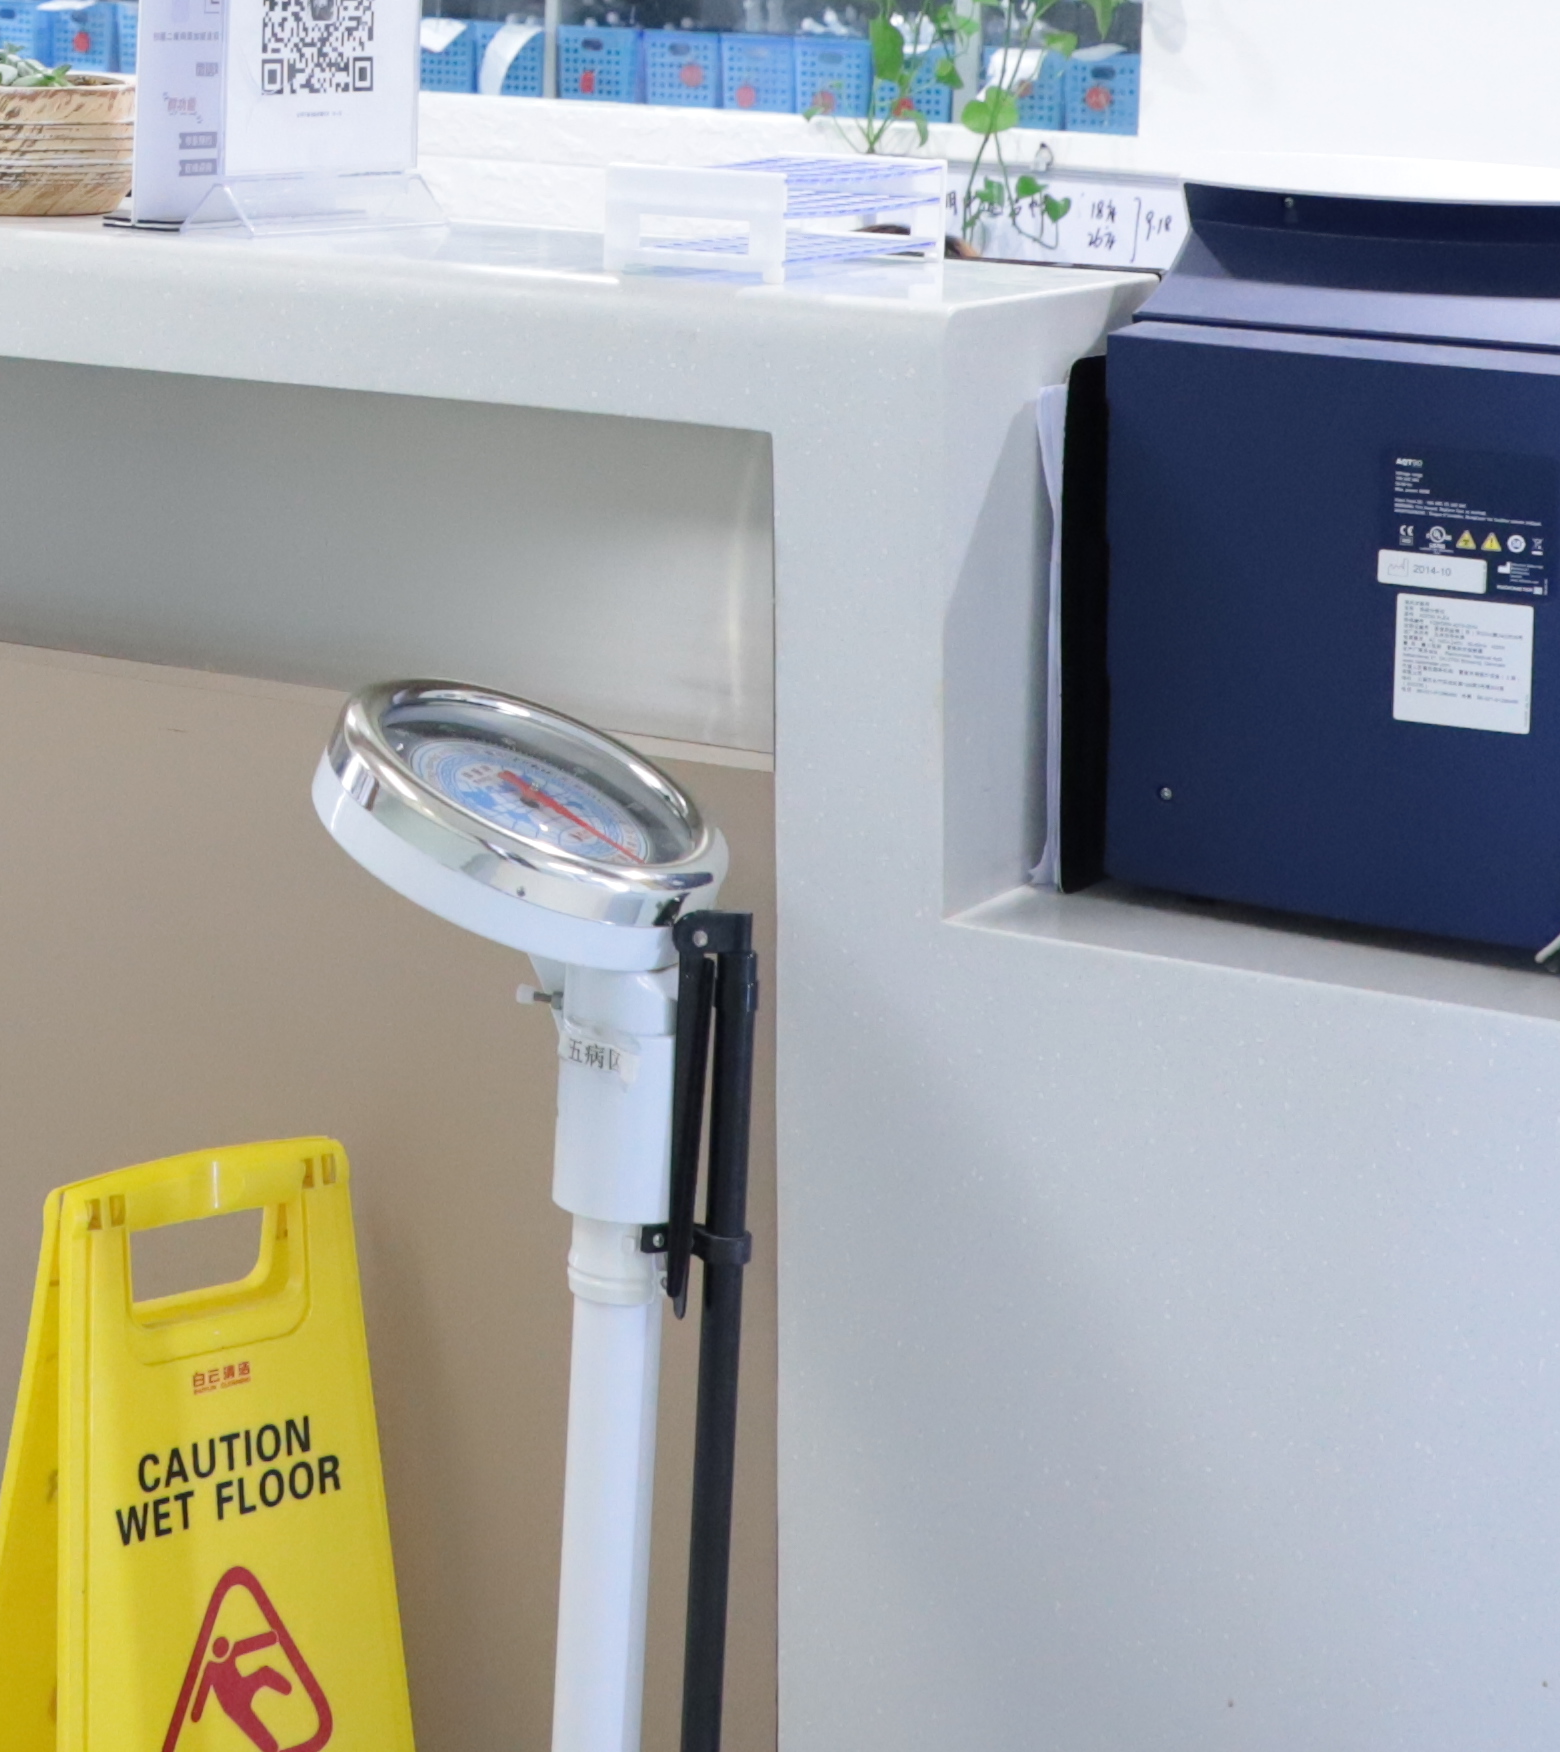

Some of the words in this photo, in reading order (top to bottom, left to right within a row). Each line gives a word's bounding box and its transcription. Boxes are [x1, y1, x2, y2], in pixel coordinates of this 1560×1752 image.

[1413, 564, 1452, 577] 2014-10
[138, 1415, 311, 1494] CAUTION
[115, 1490, 195, 1547] WET
[216, 1454, 342, 1521] FLOOR
